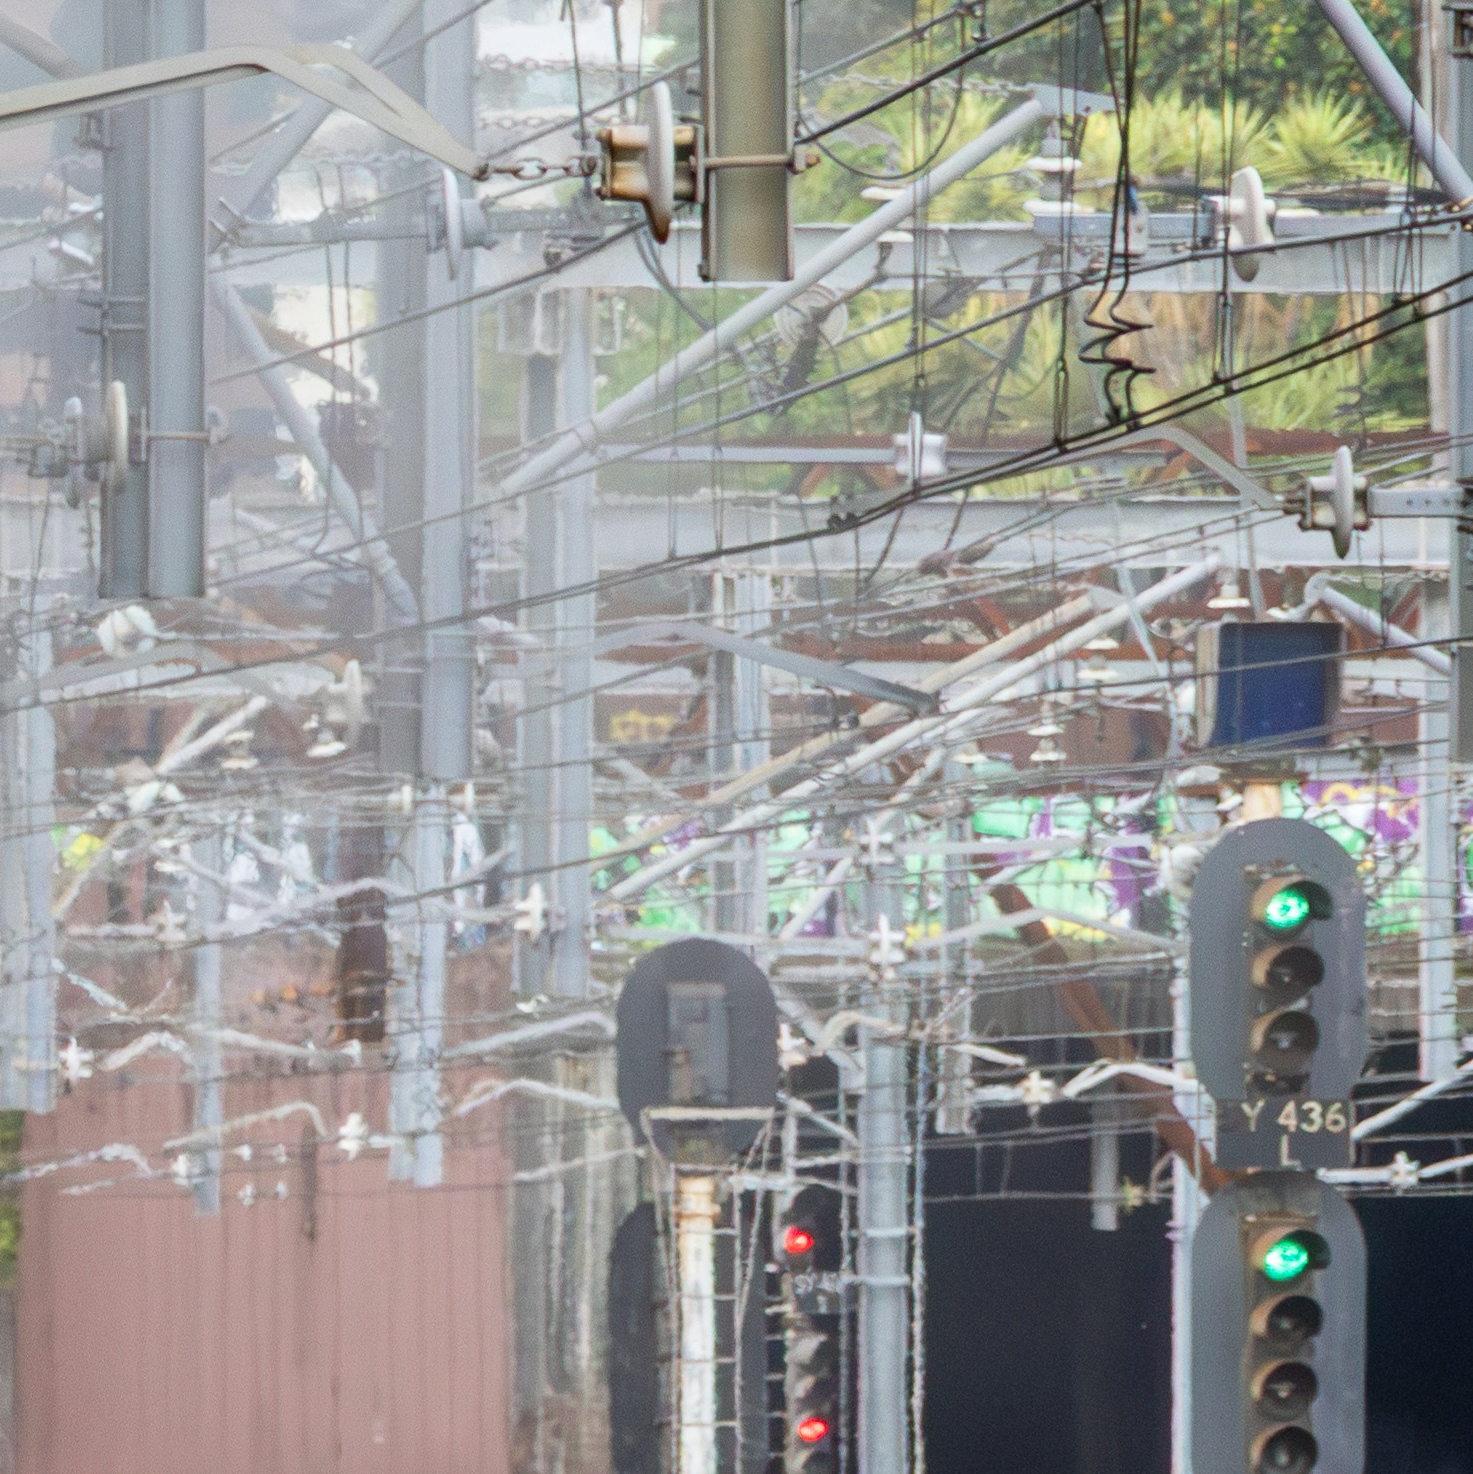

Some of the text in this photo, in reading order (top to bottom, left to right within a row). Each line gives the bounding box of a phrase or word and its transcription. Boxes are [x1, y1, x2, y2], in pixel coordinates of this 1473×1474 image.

[1240, 1099, 1347, 1134] Y 436
[1279, 1133, 1302, 1168] L
